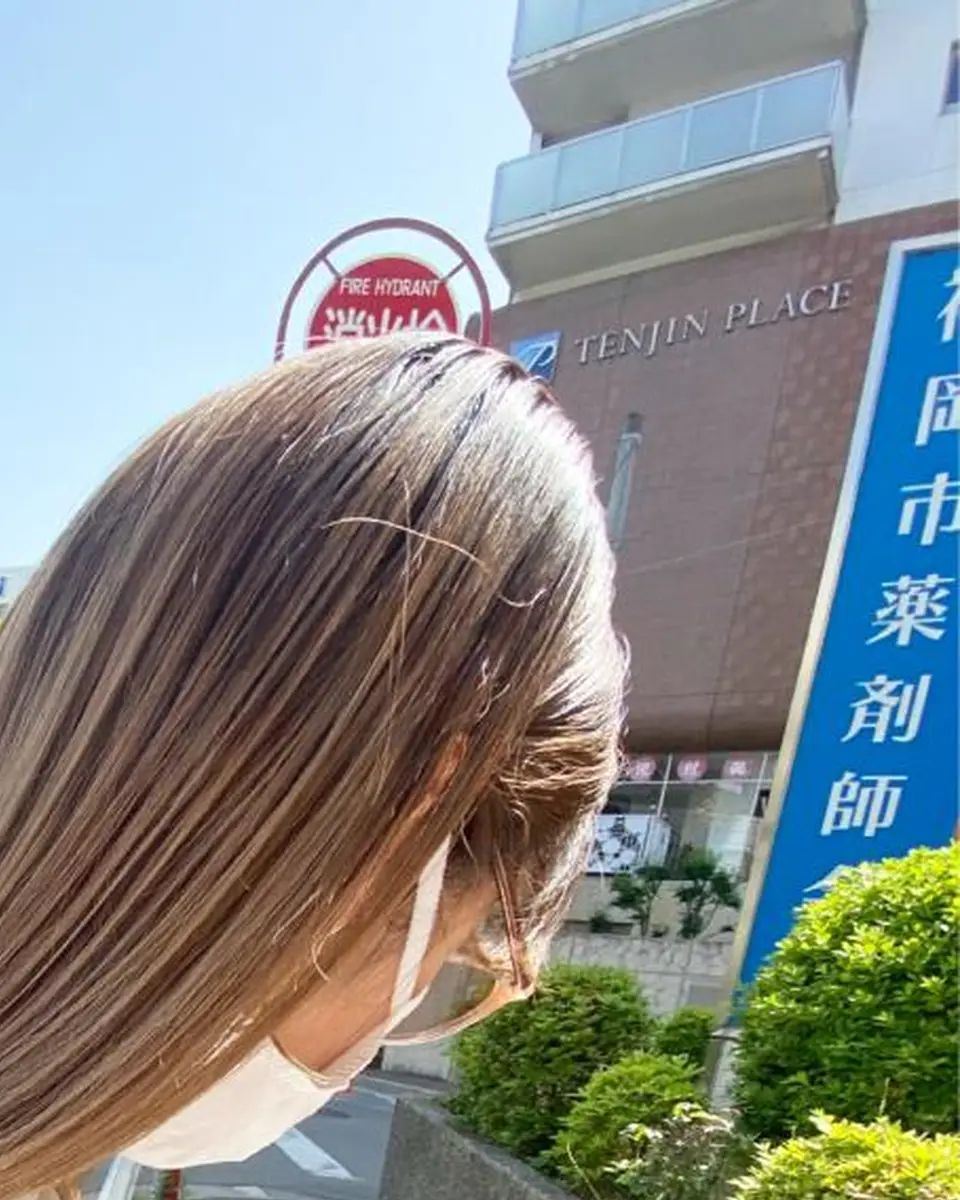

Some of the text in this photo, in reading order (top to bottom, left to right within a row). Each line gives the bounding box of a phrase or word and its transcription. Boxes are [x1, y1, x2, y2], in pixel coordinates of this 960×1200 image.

[340, 278, 440, 298] FIRE HYDRANT
[574, 278, 855, 366] TENJIN PLACE
